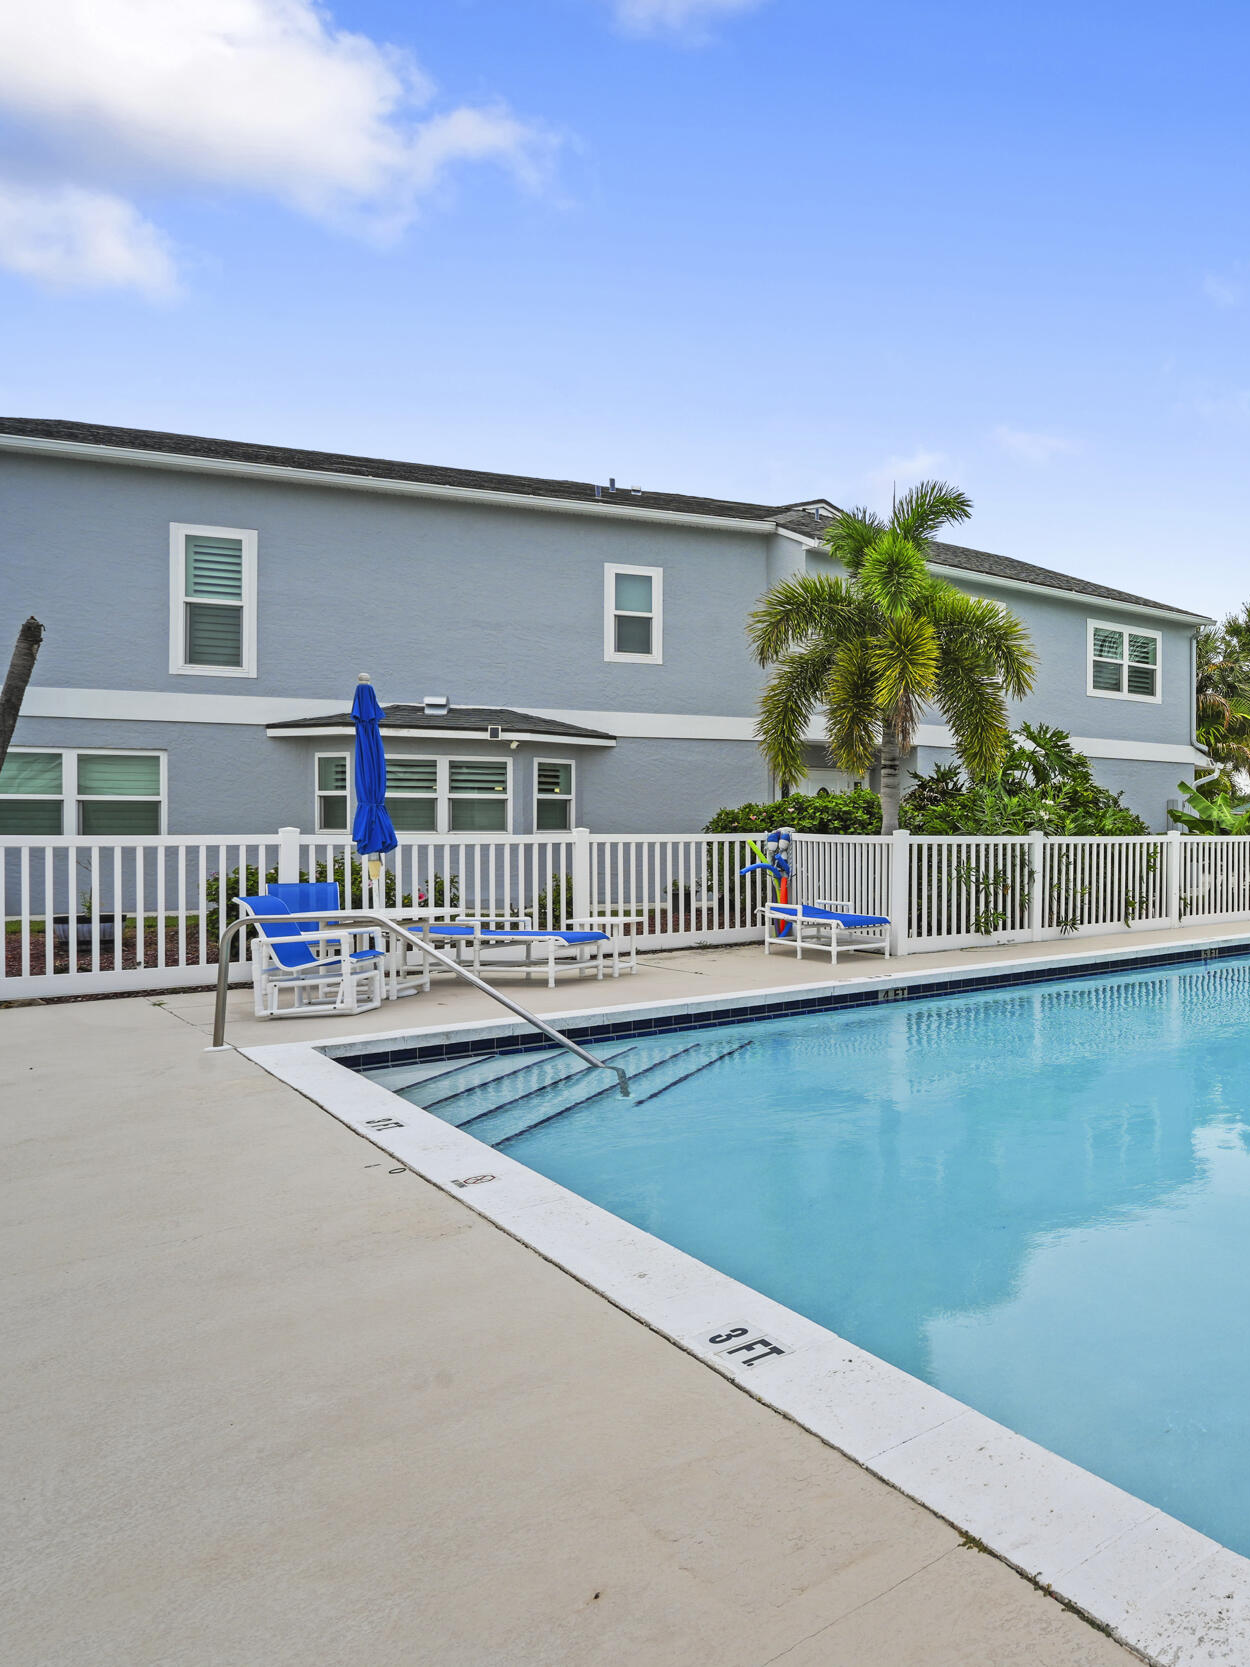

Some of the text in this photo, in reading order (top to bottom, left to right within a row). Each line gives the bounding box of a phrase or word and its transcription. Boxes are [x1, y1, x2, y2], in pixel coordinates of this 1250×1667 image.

[883, 987, 907, 999] 4 FT
[708, 1327, 786, 1367] 3 FT.
